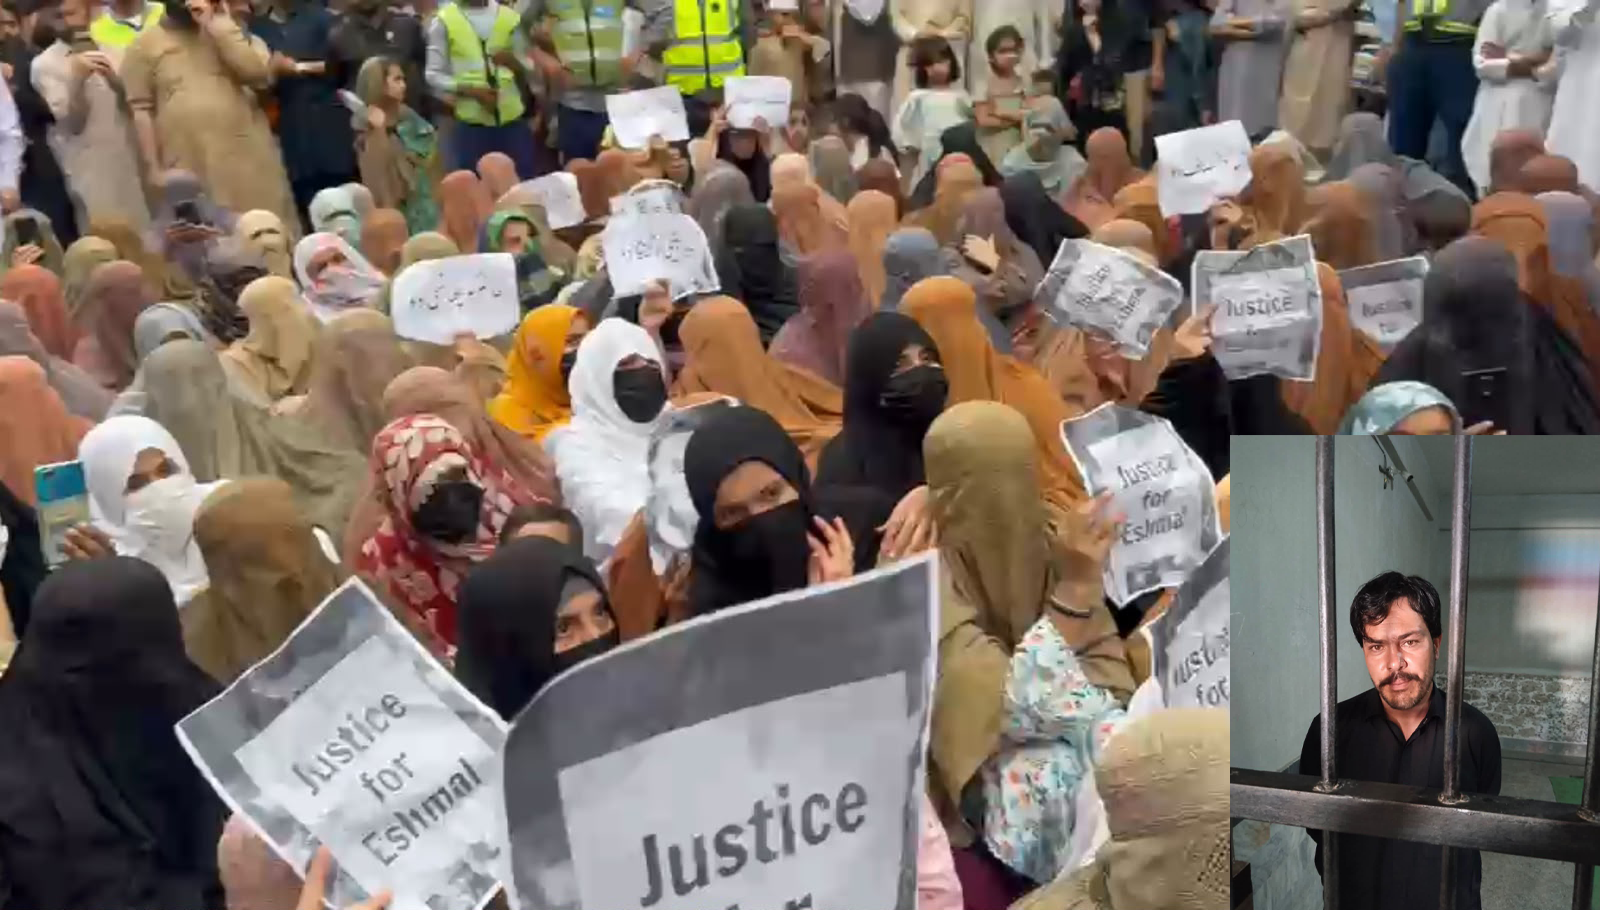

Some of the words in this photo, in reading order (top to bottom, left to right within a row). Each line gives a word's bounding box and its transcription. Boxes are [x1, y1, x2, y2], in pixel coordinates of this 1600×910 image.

[1142, 489, 1172, 510] for
[292, 694, 407, 796] Justice
[359, 752, 414, 803] for
[361, 757, 483, 867] Eshmal
[639, 782, 868, 908] Justice
